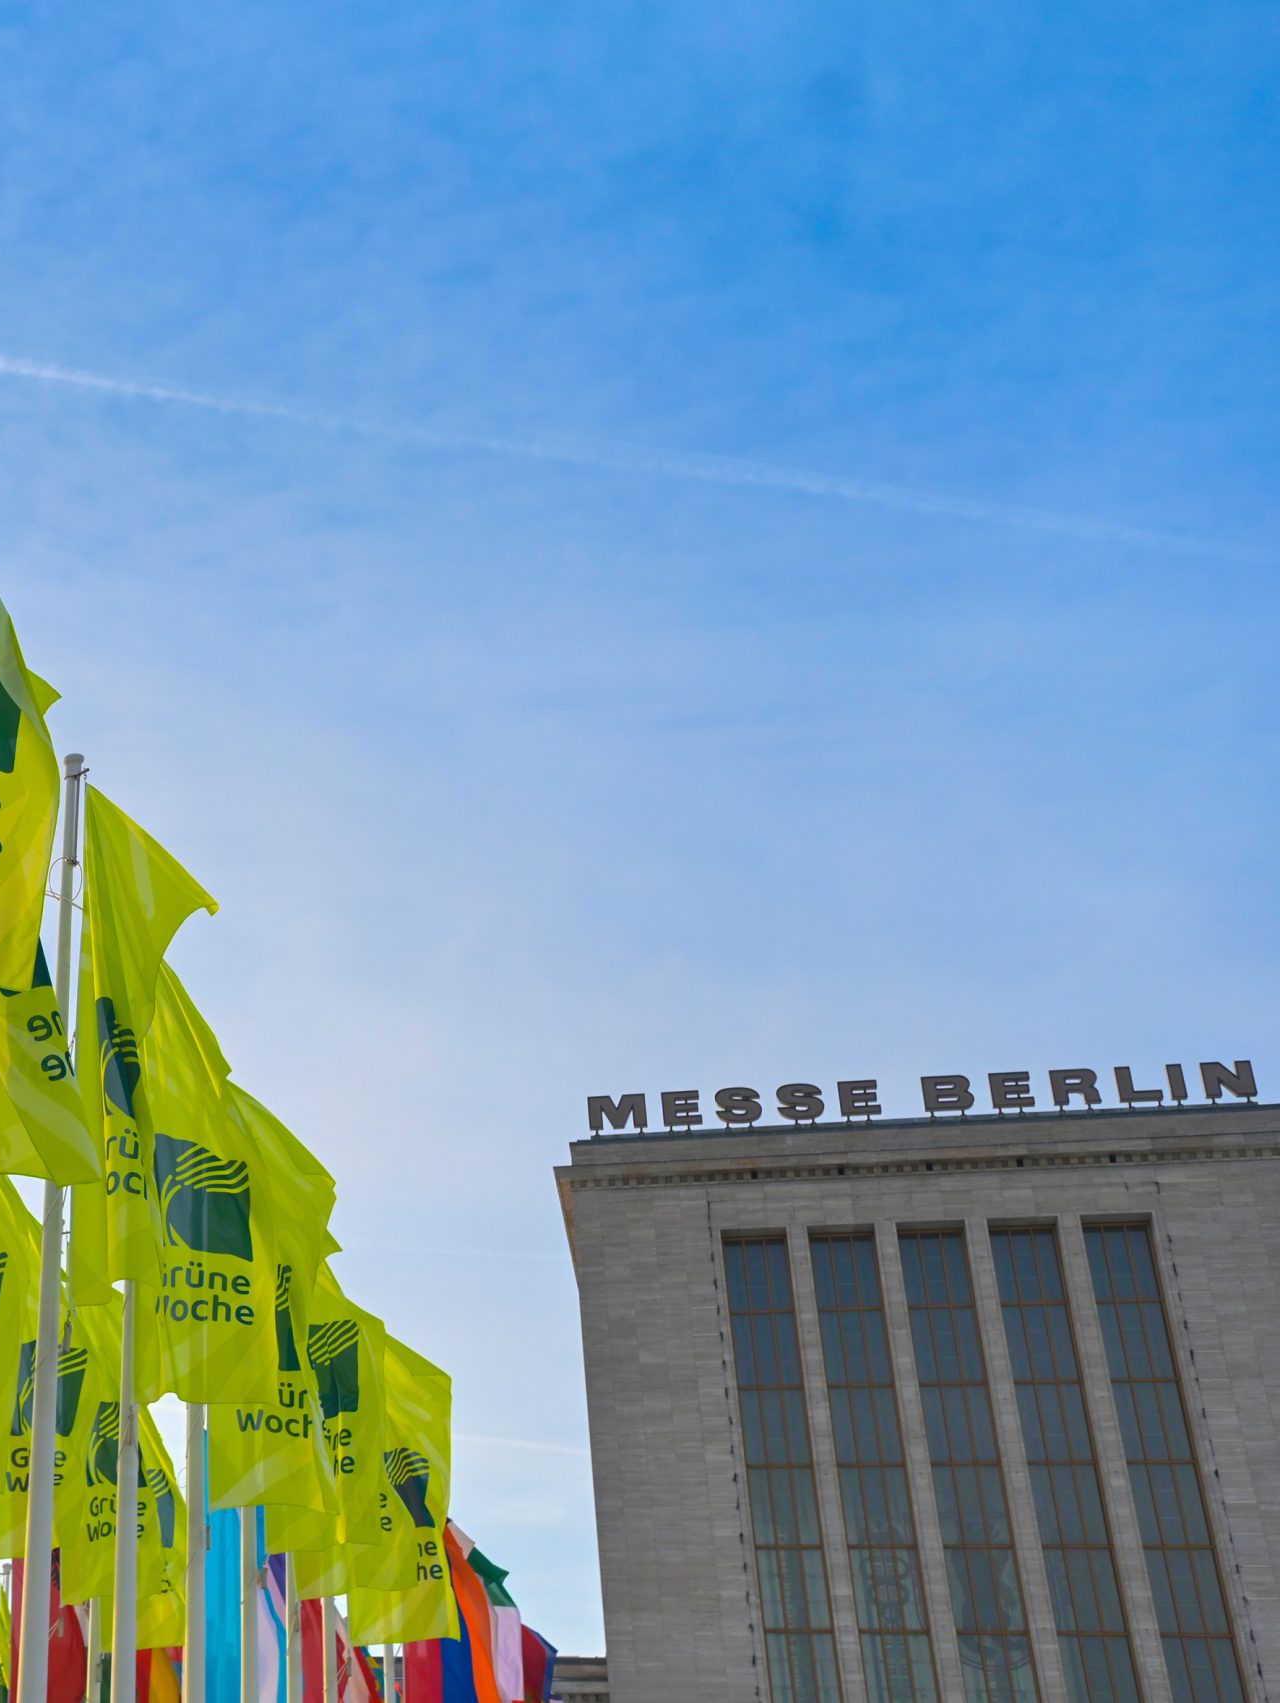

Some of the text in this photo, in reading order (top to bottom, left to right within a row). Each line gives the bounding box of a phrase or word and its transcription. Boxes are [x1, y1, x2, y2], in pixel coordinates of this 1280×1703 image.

[587, 1060, 1258, 1131] MESSE BERLIN
[236, 1409, 313, 1439] Woch
